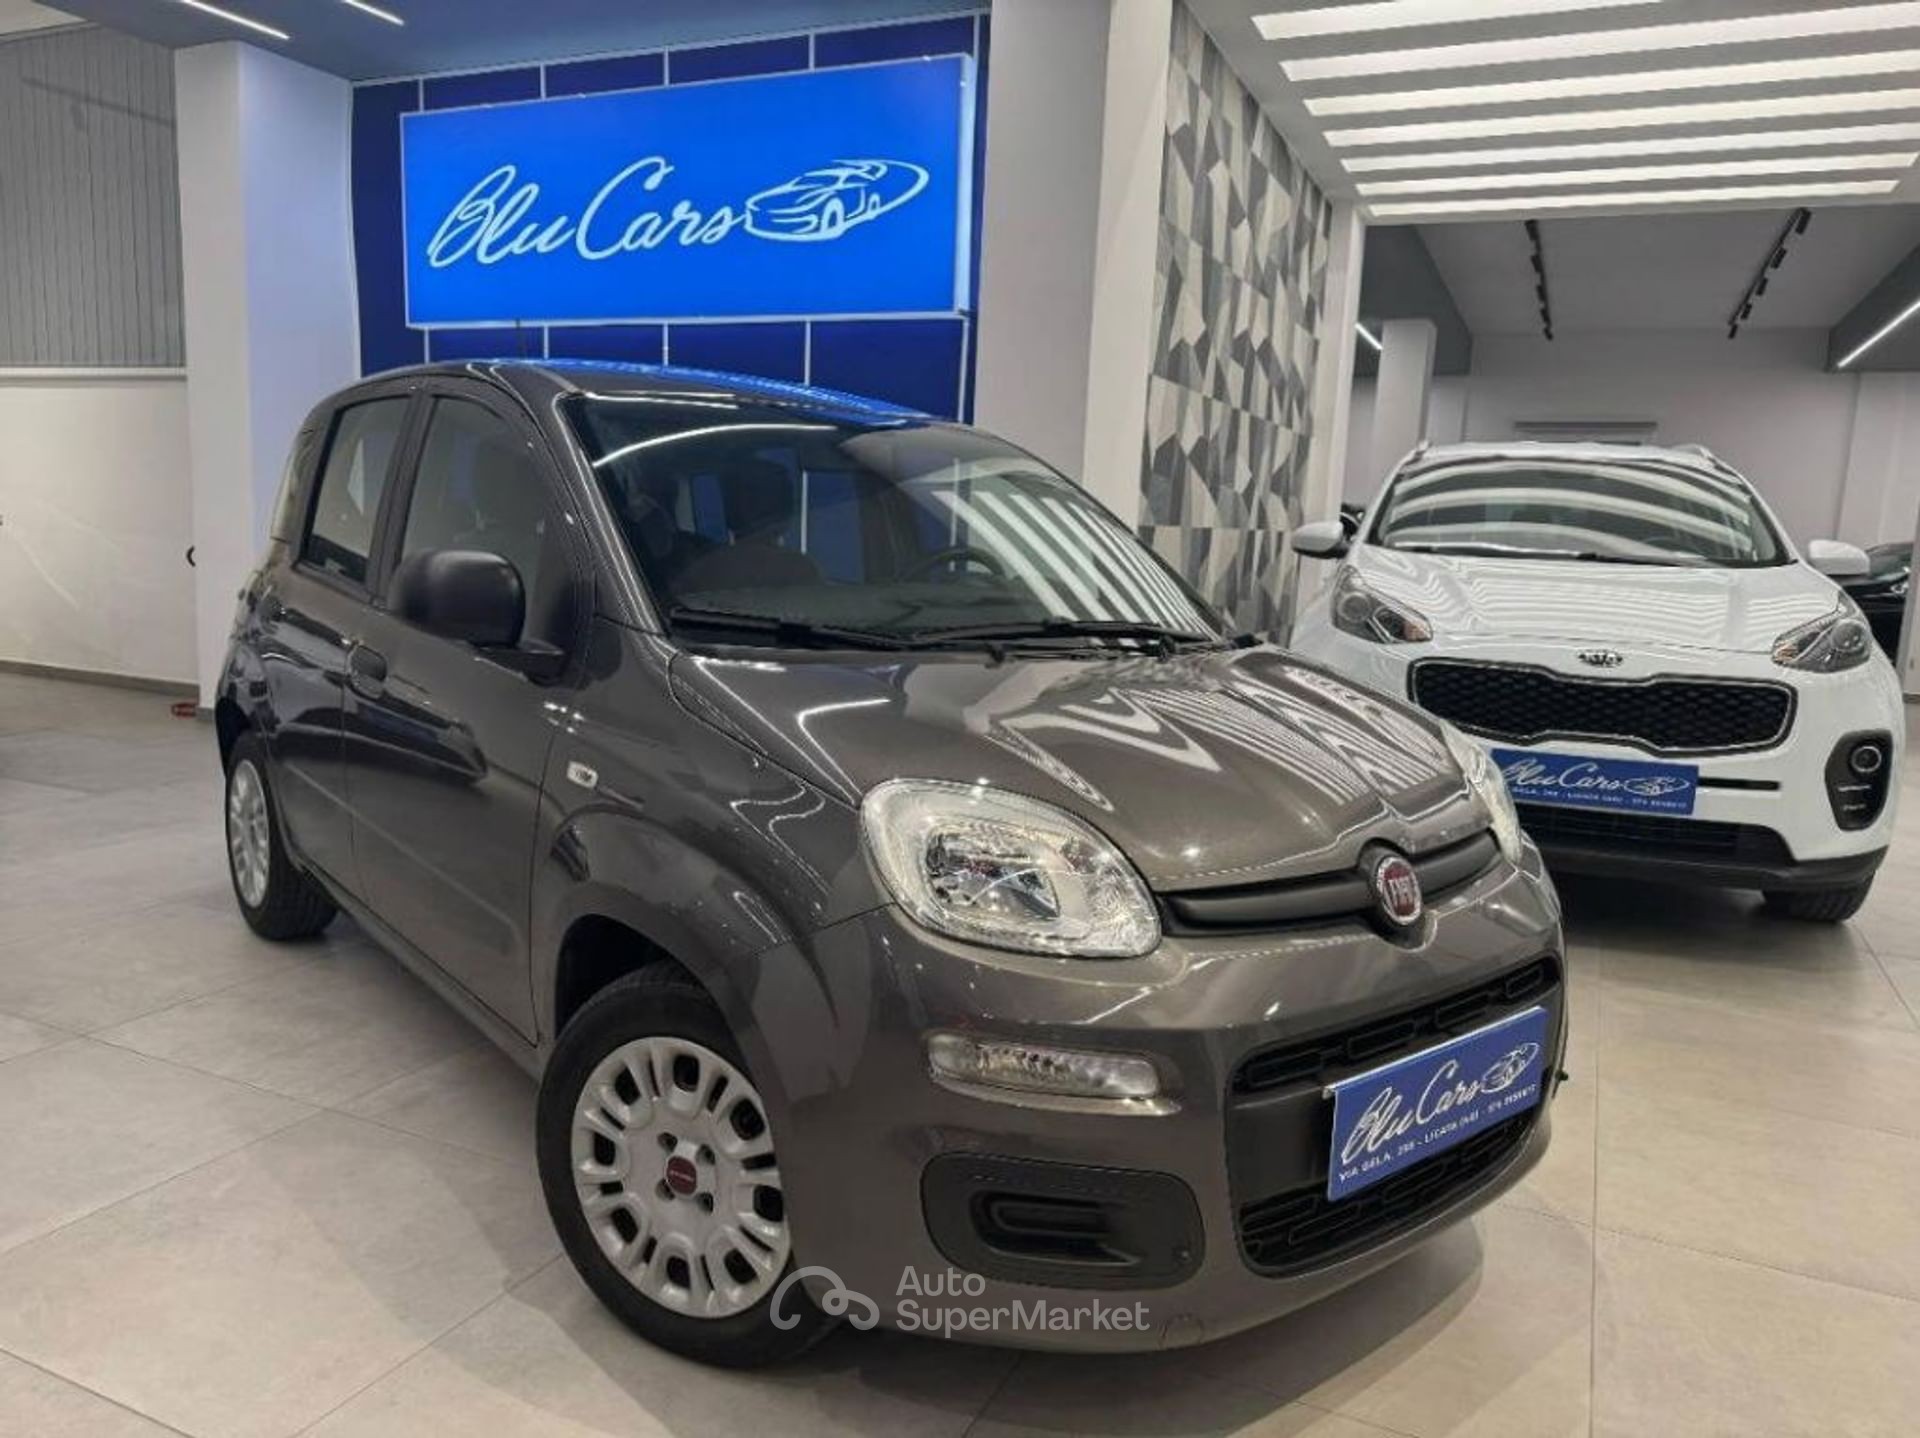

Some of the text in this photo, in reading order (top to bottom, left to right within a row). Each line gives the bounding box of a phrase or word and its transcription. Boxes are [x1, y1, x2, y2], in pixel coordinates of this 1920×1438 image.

[427, 155, 745, 268] Blu Cars
[1558, 761, 1624, 790] Cars
[1341, 1060, 1481, 1165] Blu Cars
